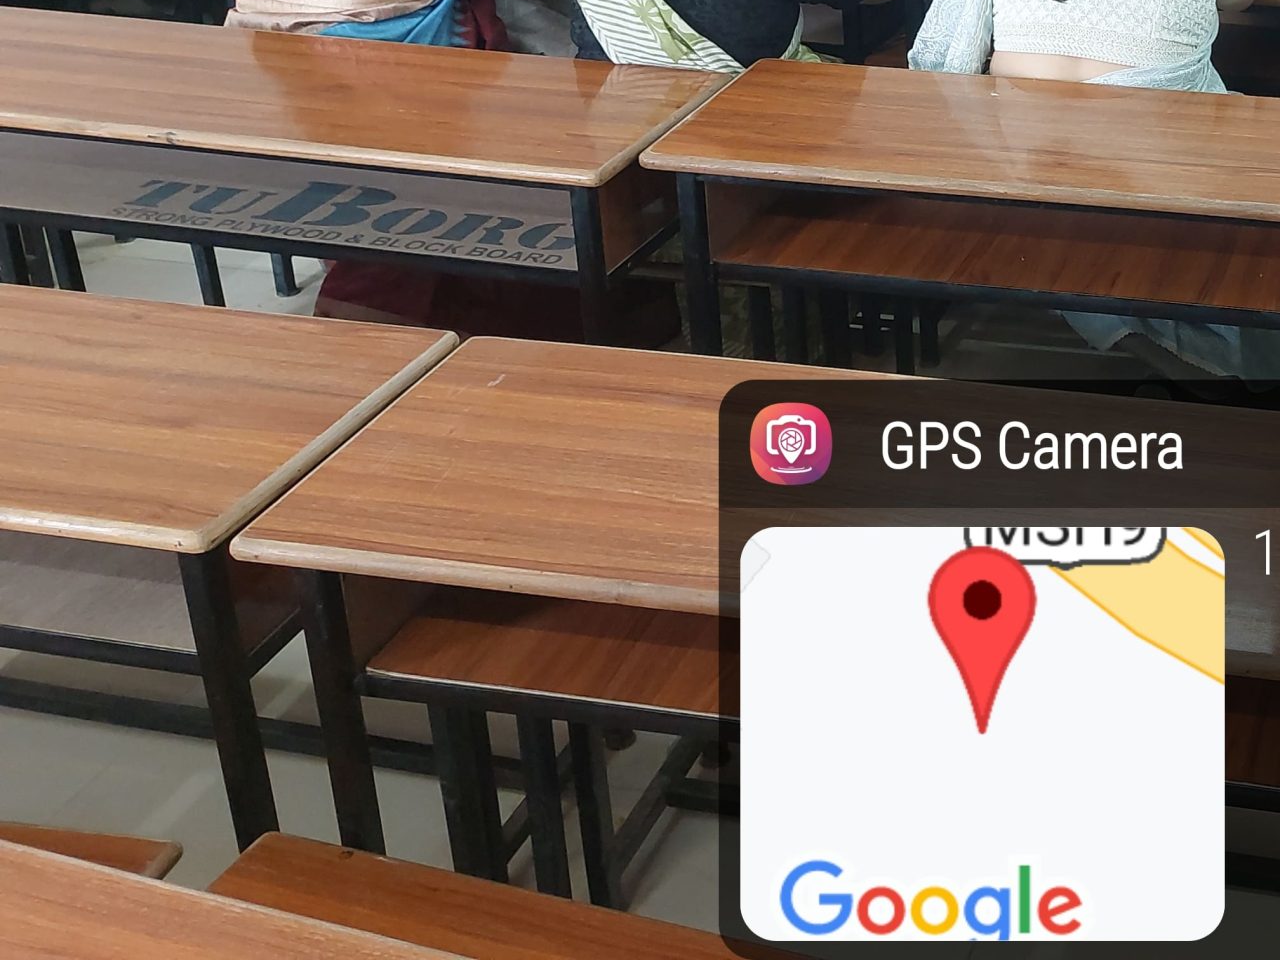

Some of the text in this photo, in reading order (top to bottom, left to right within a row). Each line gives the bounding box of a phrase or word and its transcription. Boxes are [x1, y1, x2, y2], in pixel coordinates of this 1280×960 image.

[111, 206, 564, 265] STRONG PLYWOOD & BLOCK BOARD
